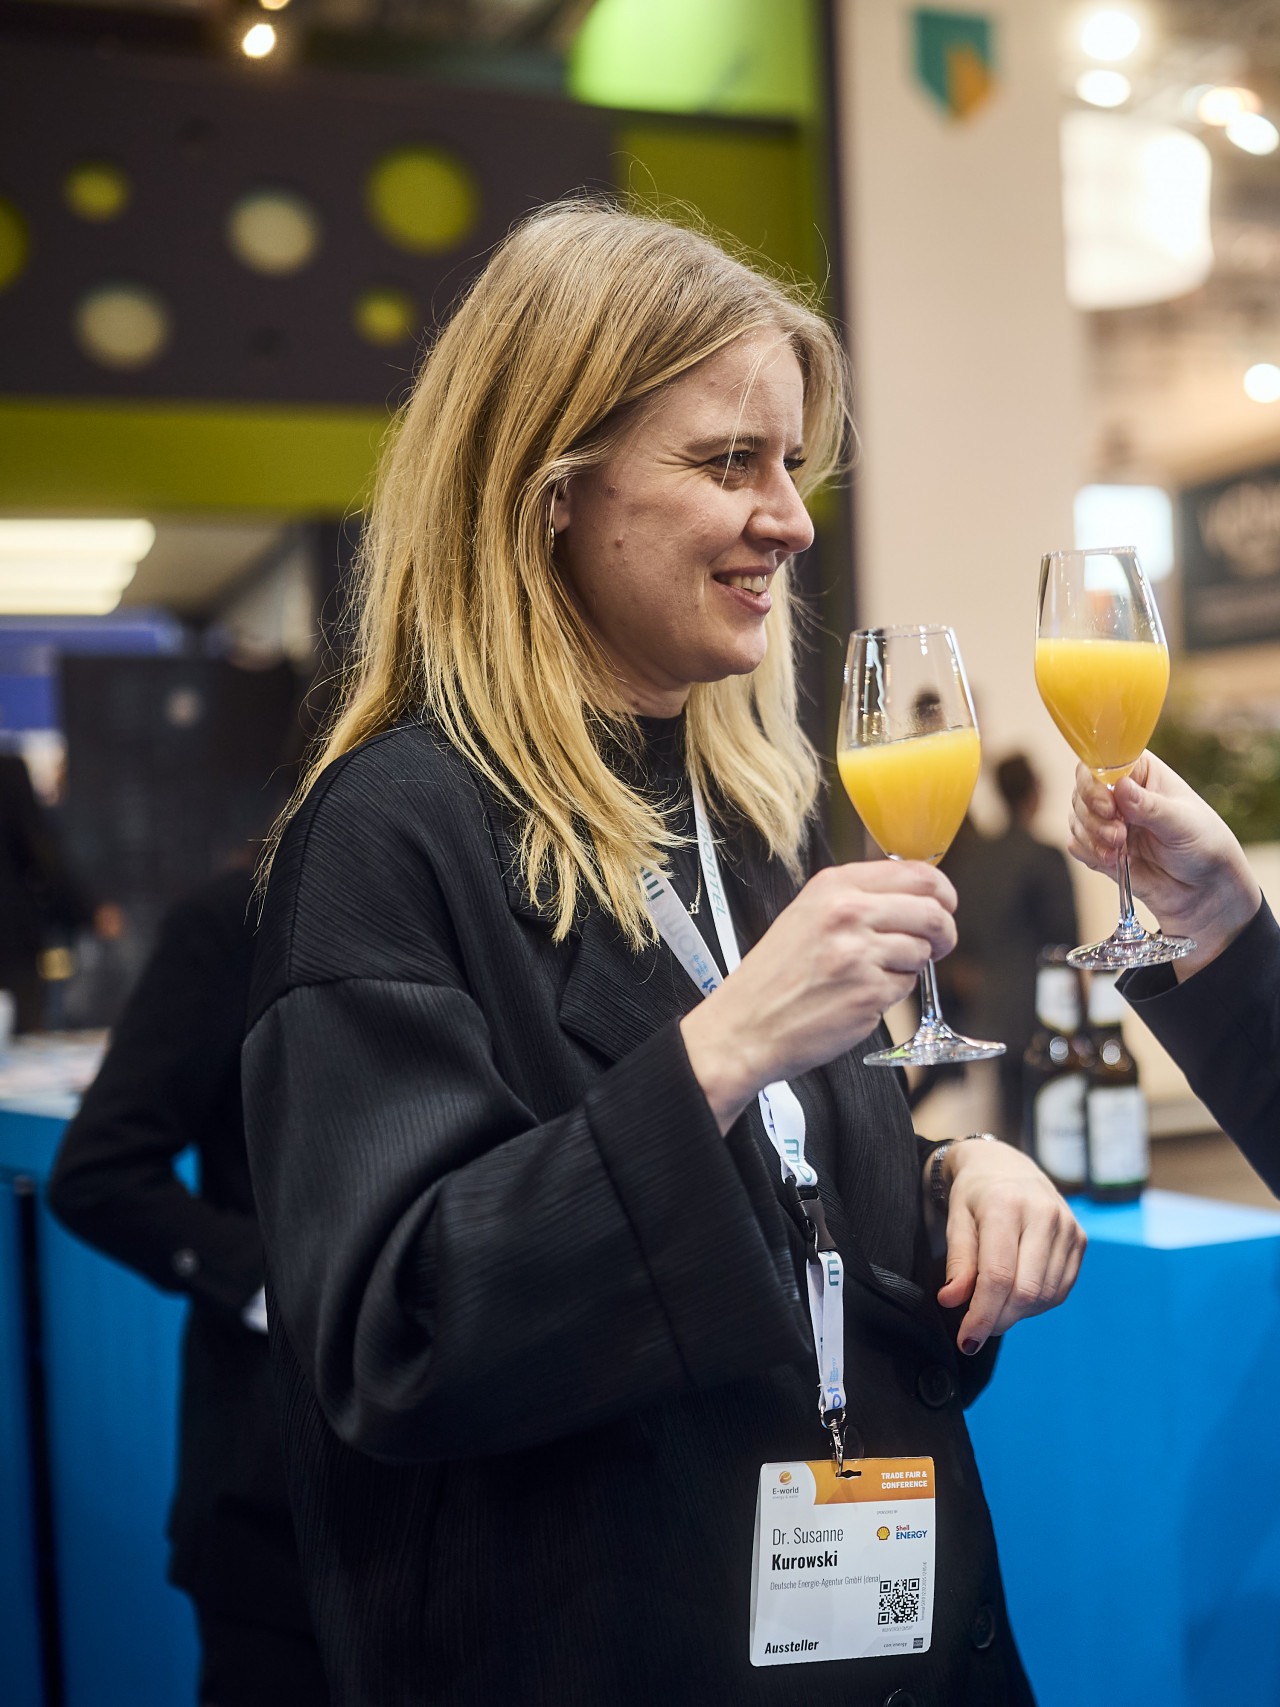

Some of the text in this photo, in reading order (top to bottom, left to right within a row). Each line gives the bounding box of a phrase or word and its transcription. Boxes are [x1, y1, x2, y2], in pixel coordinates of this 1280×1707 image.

[772, 1487, 799, 1495] E-world
[881, 1480, 928, 1489] CONFERENCE
[772, 1527, 844, 1545] Dr. Susanne
[896, 1530, 928, 1540] ENERGY
[771, 1550, 838, 1571] Kurowski
[770, 1581, 797, 1591] Deutsche
[798, 1578, 843, 1590] Energie-Agentur
[844, 1576, 862, 1585] GmbH
[764, 1639, 819, 1654] Aussteller
